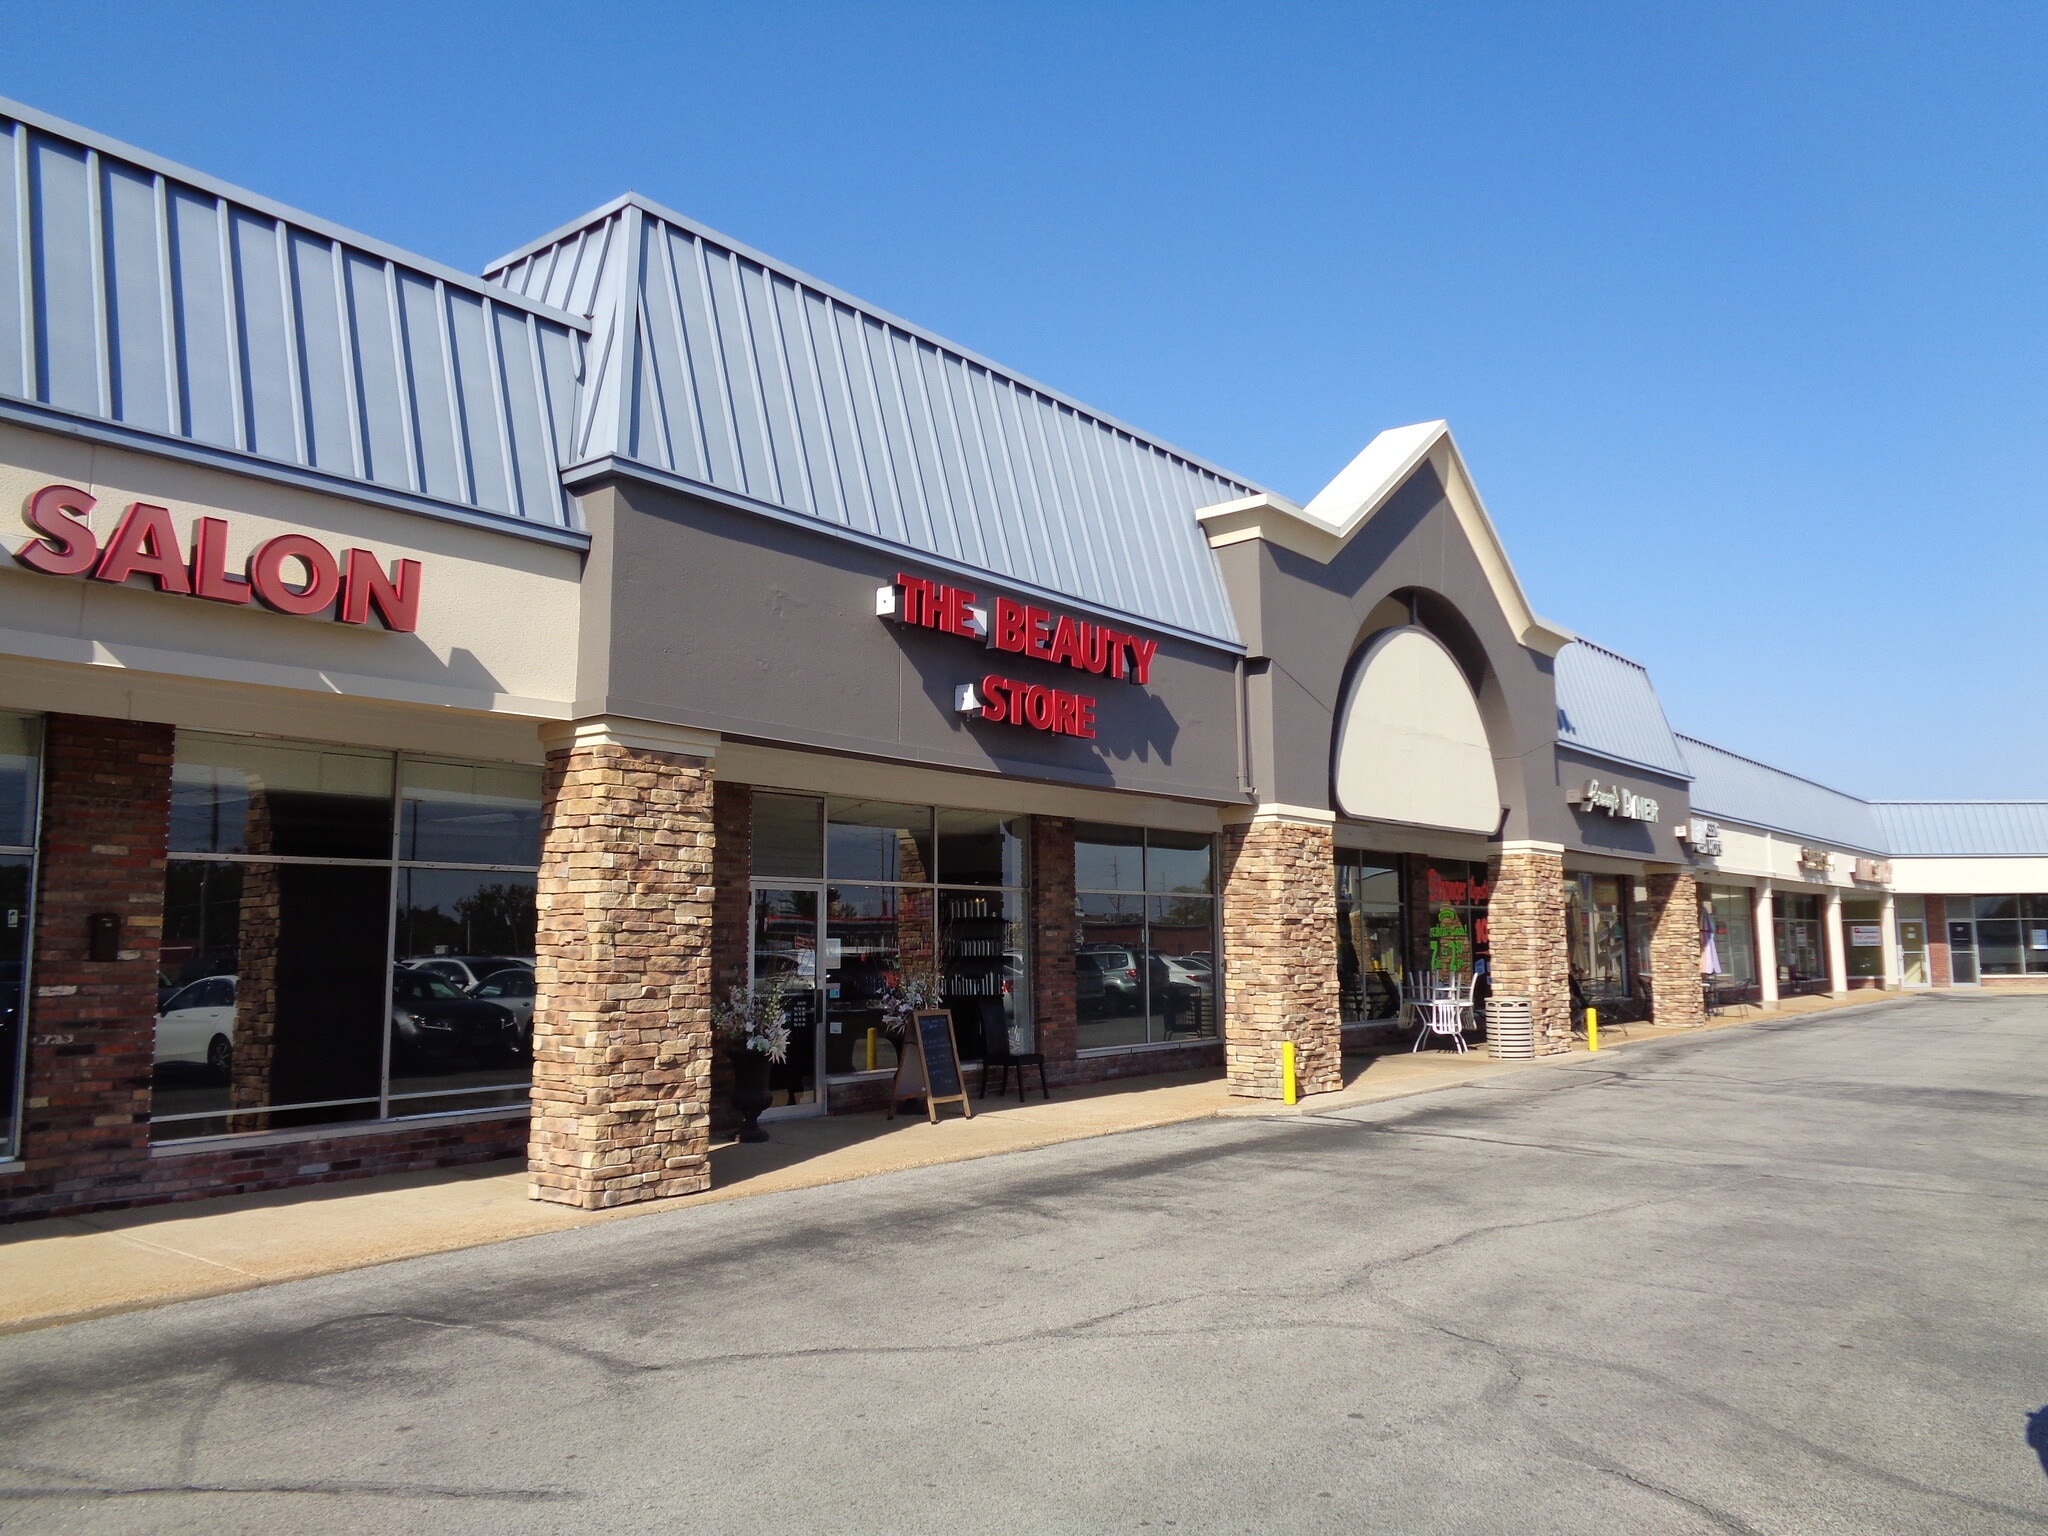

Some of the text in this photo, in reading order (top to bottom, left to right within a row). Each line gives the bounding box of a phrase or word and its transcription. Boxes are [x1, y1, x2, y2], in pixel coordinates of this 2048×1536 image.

[13, 484, 422, 634] SALON
[896, 572, 1158, 685] THE BEAUTY
[981, 674, 1097, 739] STORE
